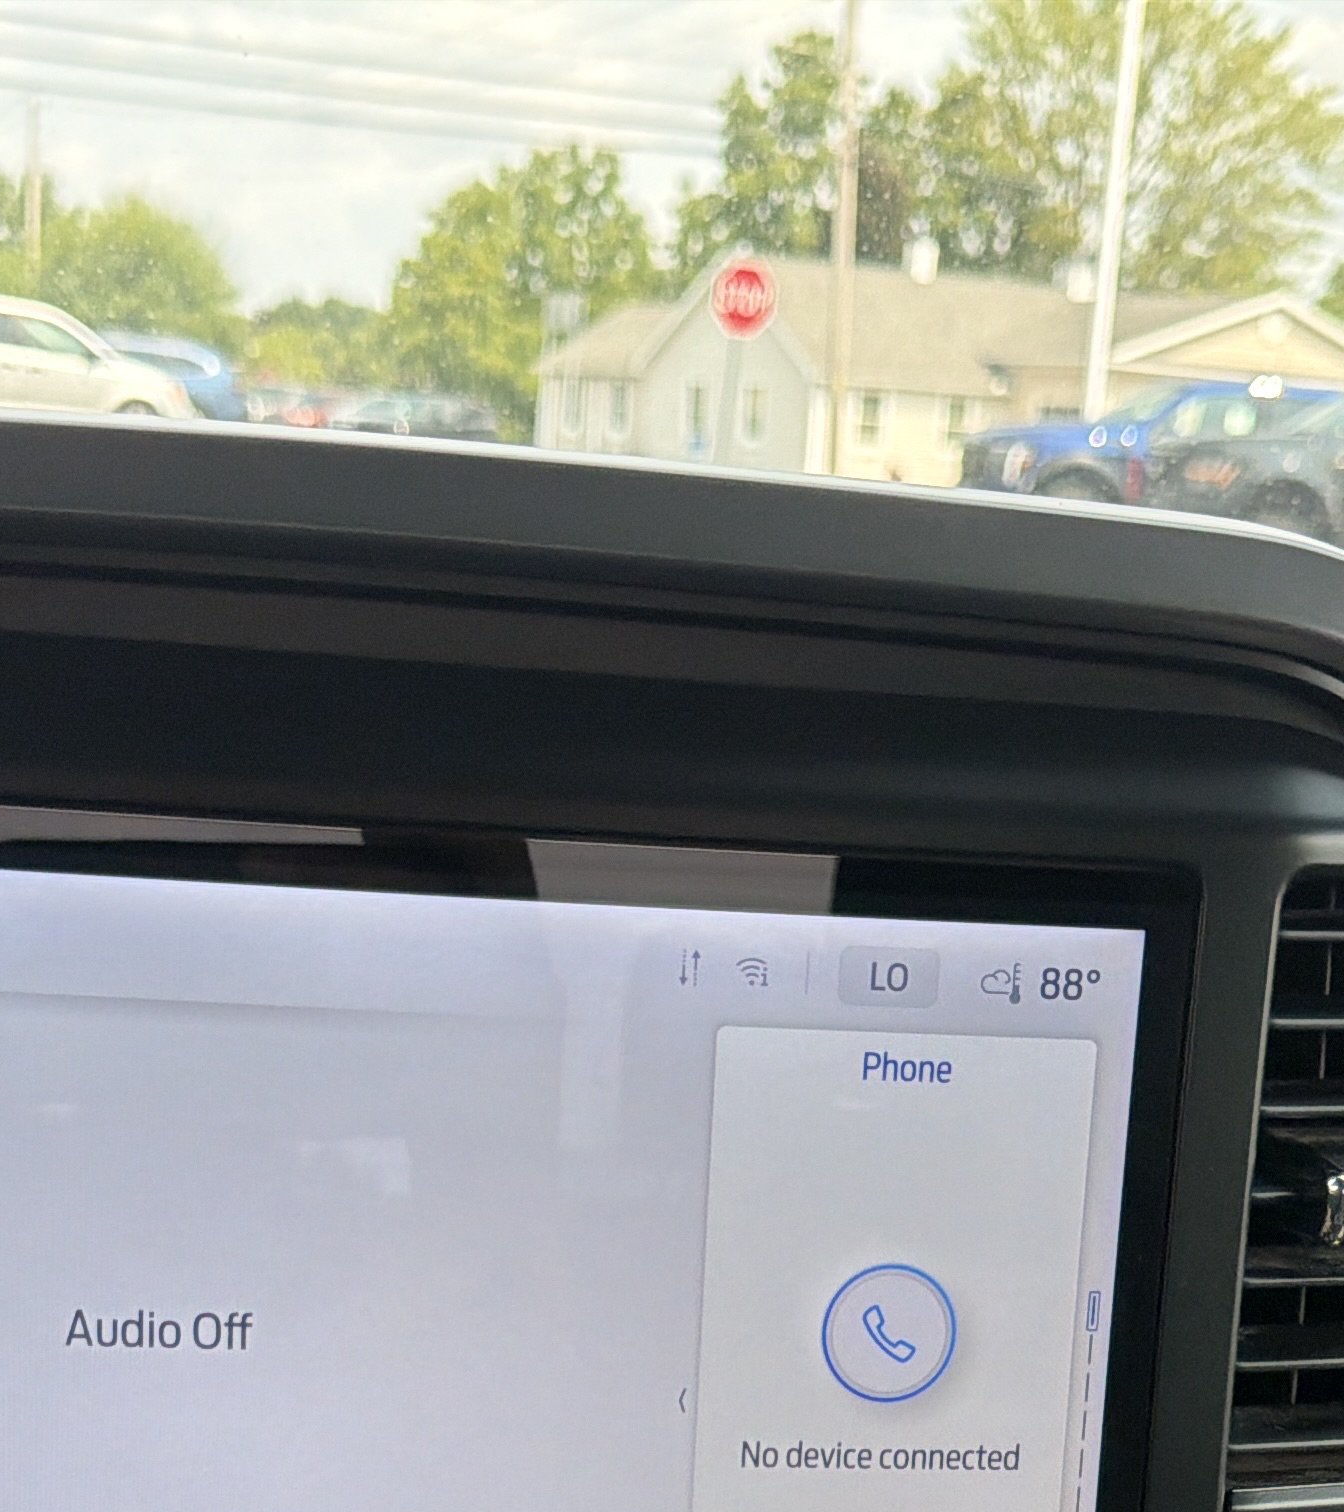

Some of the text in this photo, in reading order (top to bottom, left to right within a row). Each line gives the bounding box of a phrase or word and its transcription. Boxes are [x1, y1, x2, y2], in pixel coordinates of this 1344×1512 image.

[870, 961, 909, 993] LO
[861, 1050, 953, 1084] Phone
[65, 1308, 254, 1351] Audio Off
[739, 1439, 1021, 1472] No device connected
